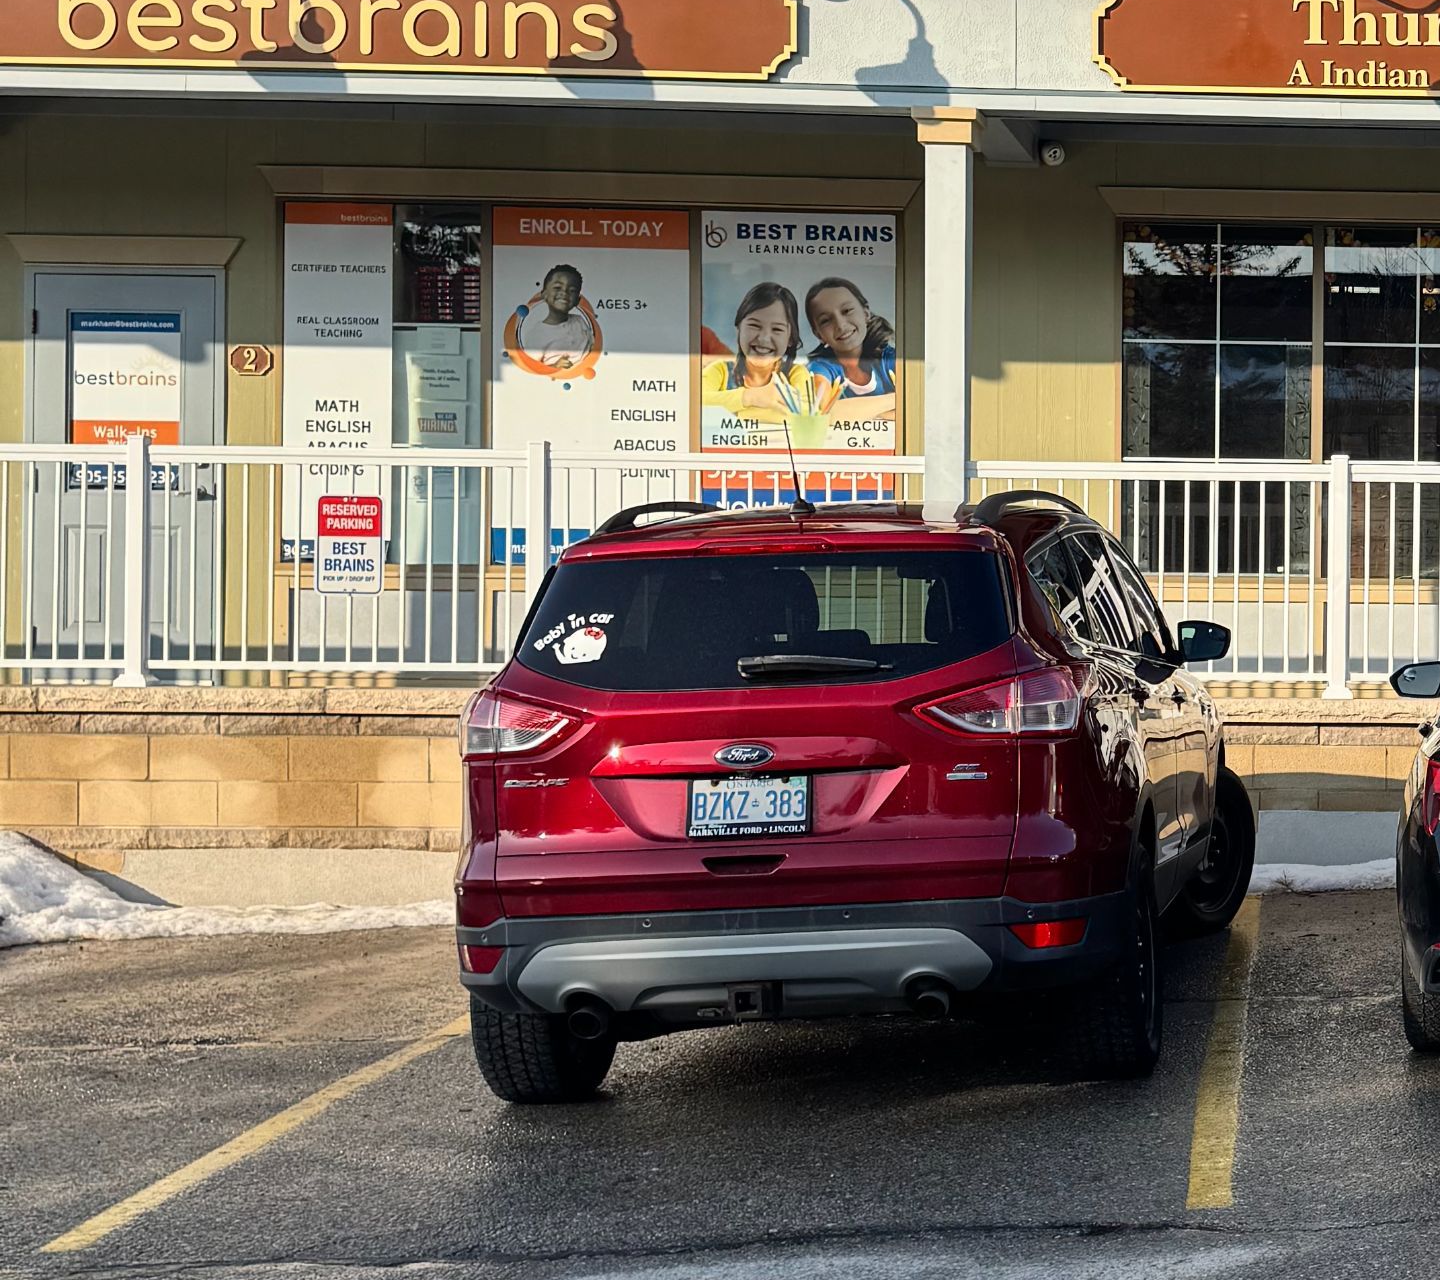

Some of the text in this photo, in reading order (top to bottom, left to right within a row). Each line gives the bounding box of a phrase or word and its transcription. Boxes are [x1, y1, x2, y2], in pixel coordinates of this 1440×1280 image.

[1287, 59, 1311, 86] A
[1321, 60, 1430, 88] Indian
[519, 218, 664, 237] ENROLL TODAY
[737, 223, 894, 242] BEST BRAINS
[749, 244, 875, 256] LEARNING CENTERS
[291, 263, 387, 274] CERTIFIED TEACHERS
[596, 299, 648, 310] AGES 3+
[296, 316, 380, 326] REAL CLASSROOM
[314, 328, 363, 338] TEACHING
[243, 347, 256, 371] 2
[74, 370, 178, 387] bestbrains
[632, 379, 676, 392] MATH
[315, 399, 359, 412] MATH
[611, 409, 676, 422] ENGLISH
[306, 419, 371, 433] ENGLISH
[420, 418, 456, 432] HIRING
[720, 418, 759, 430] MATH
[833, 420, 889, 432] ABACUS
[93, 424, 158, 439] Walk-Ins
[614, 439, 676, 452] ABACUS
[712, 434, 768, 446] ENGLISH
[847, 437, 875, 448] G.K.
[322, 504, 378, 516] RESERVED
[326, 518, 374, 530] PARKING
[332, 542, 367, 555] BEST
[324, 558, 375, 572] BRAINS
[533, 613, 615, 651] Baby in car
[727, 748, 760, 761] Ford
[694, 789, 806, 821] BZKZ 383
[689, 824, 806, 837] MARKVILLE FORD LINCOLN
